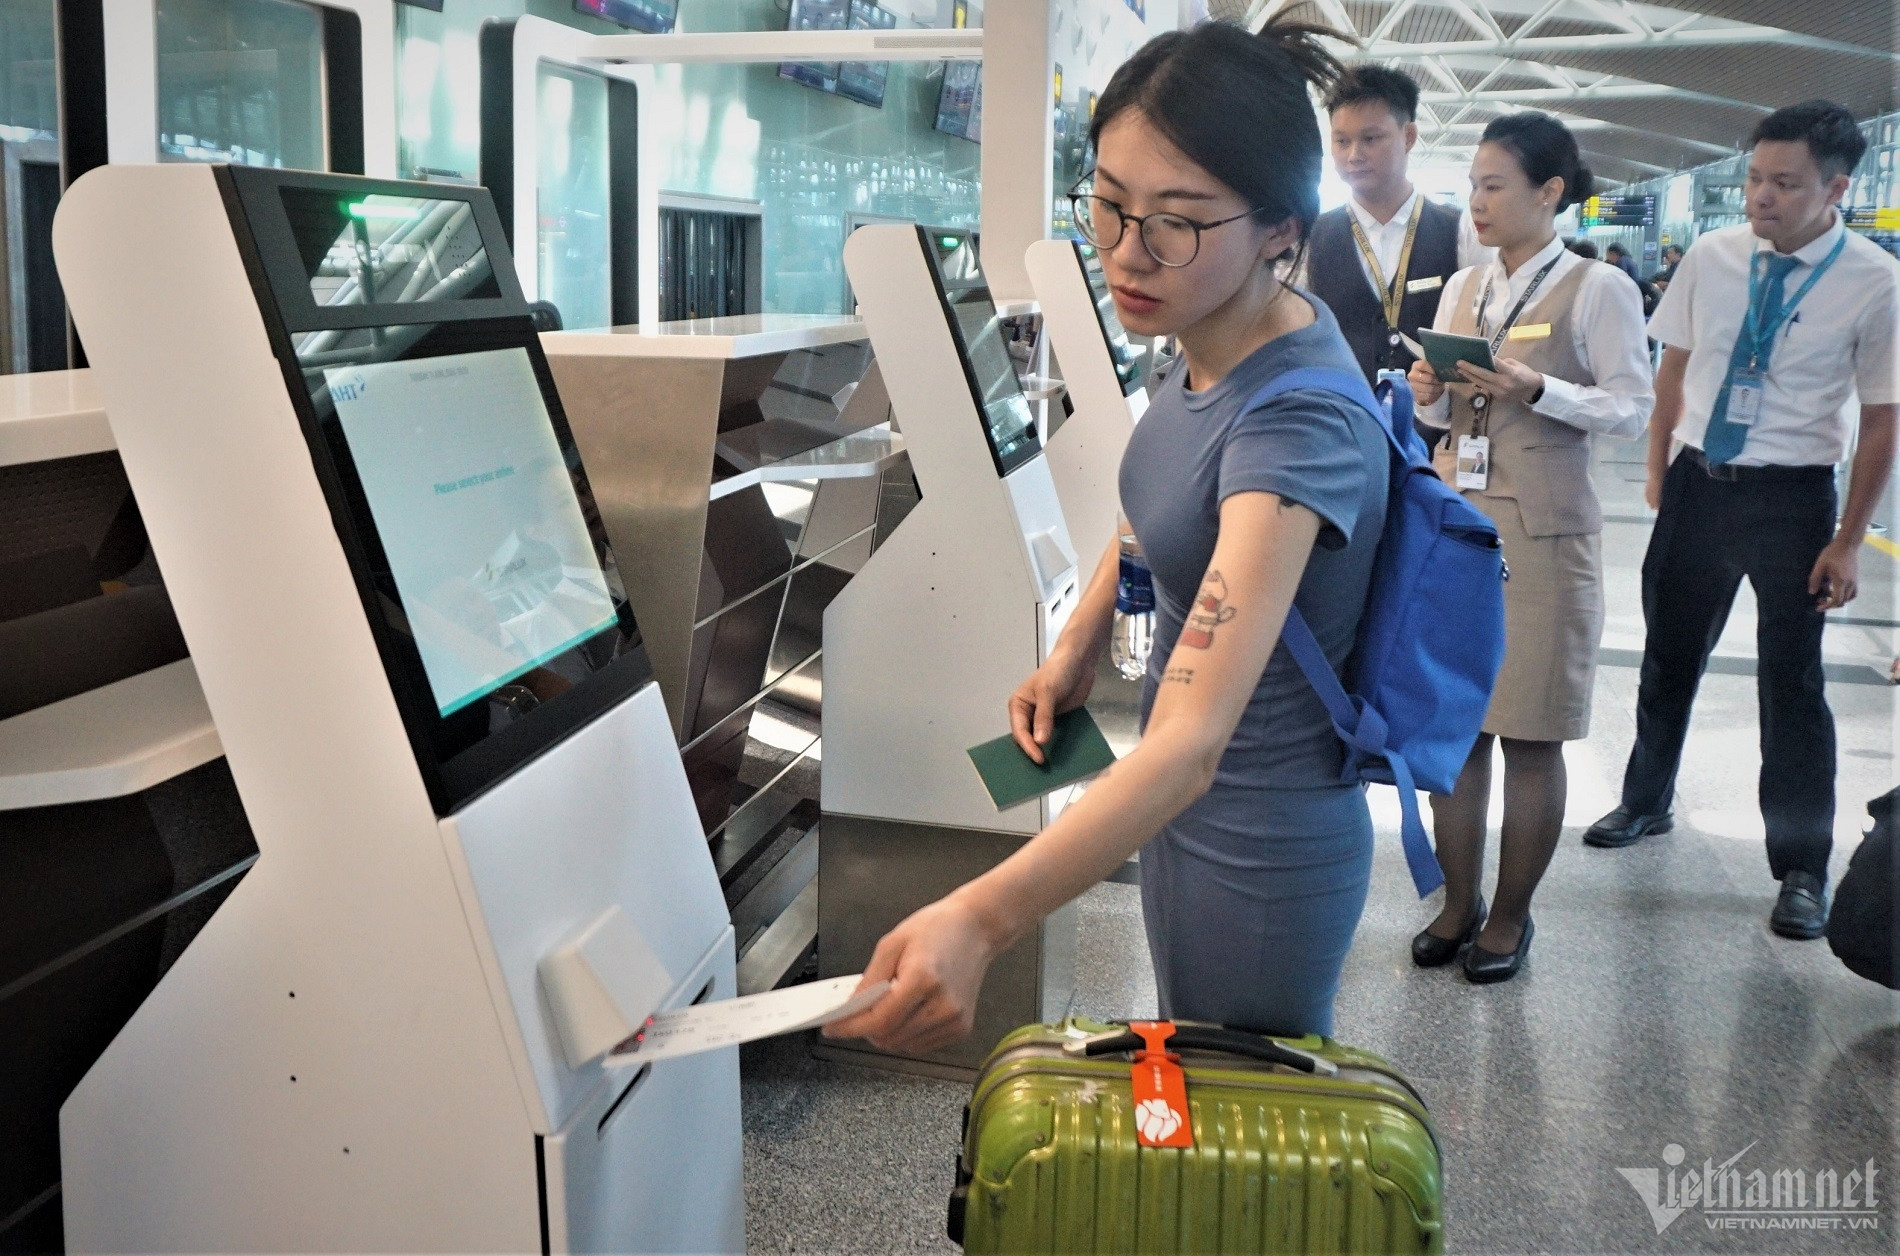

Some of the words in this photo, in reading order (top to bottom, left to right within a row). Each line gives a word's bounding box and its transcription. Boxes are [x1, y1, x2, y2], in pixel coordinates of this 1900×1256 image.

[1394, 273, 1406, 306] STARLUX
[1521, 269, 1548, 302] STARLUX
[433, 483, 458, 495] Please
